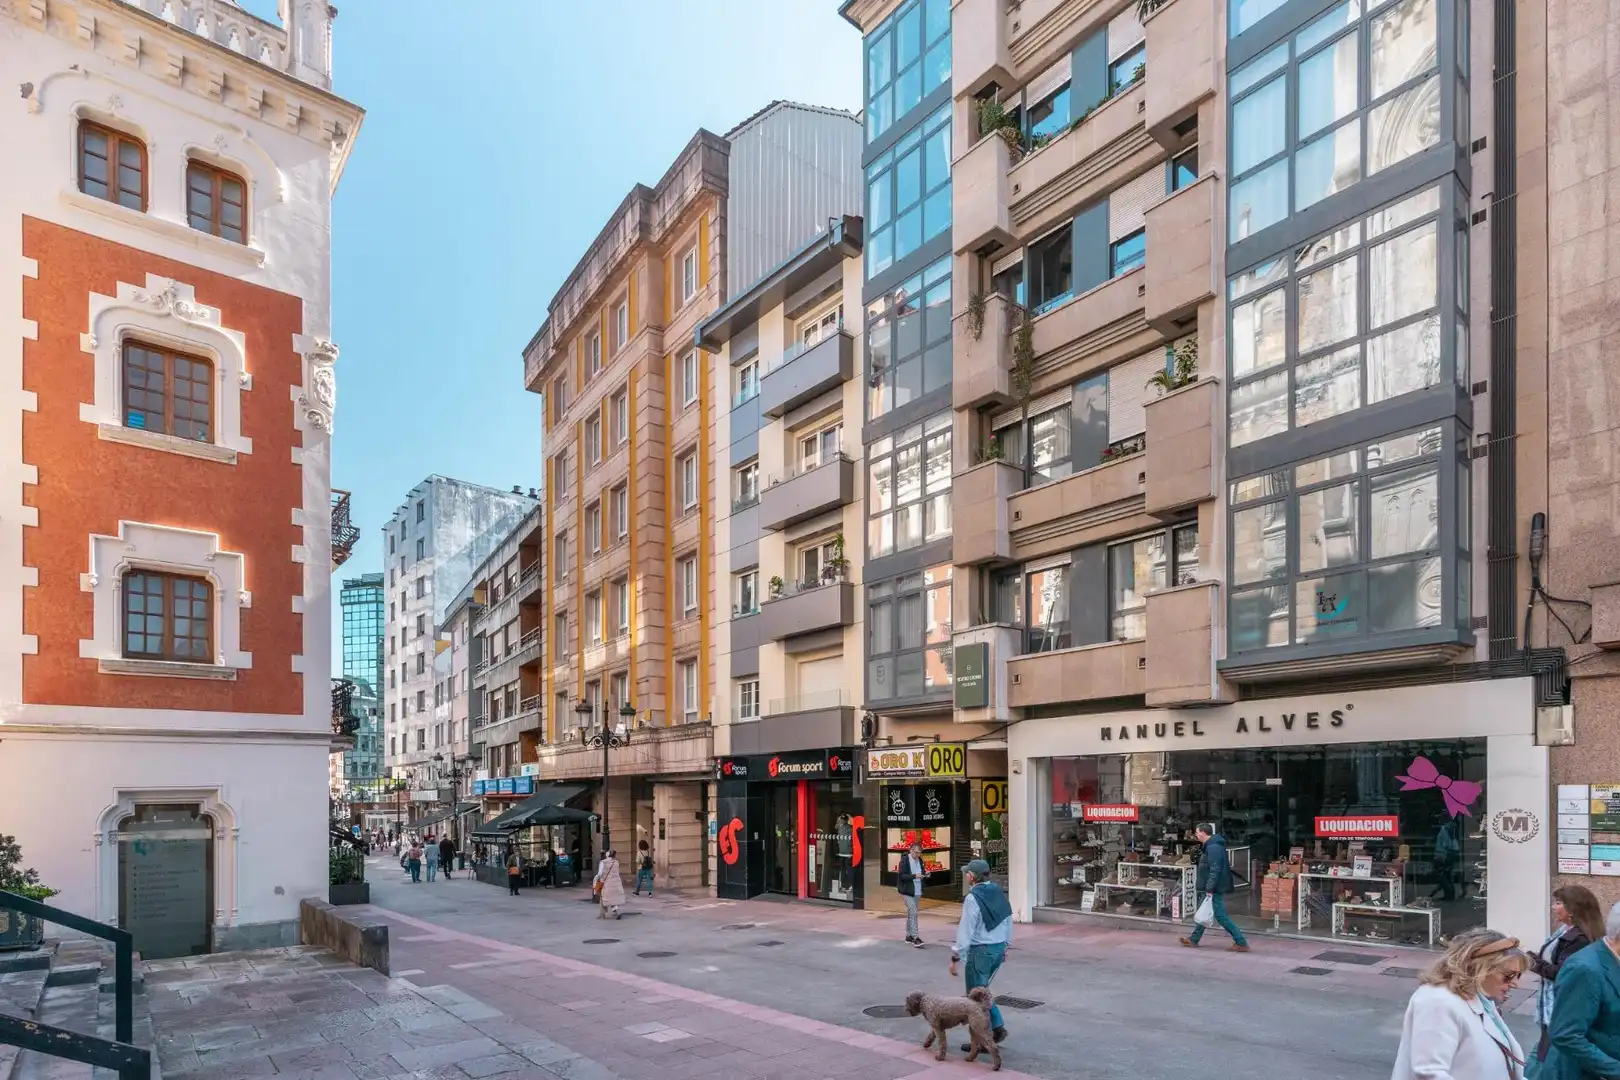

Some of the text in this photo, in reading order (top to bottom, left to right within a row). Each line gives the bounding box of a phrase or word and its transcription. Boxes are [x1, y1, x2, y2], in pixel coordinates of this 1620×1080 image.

[1100, 710, 1344, 741] MANUEL ALVES
[778, 761, 823, 774] forum sport
[880, 752, 908, 769] ORO
[930, 747, 963, 774] ORO
[1087, 807, 1135, 817] LIQUIDACION
[1320, 820, 1393, 832] LIQUIDACION
